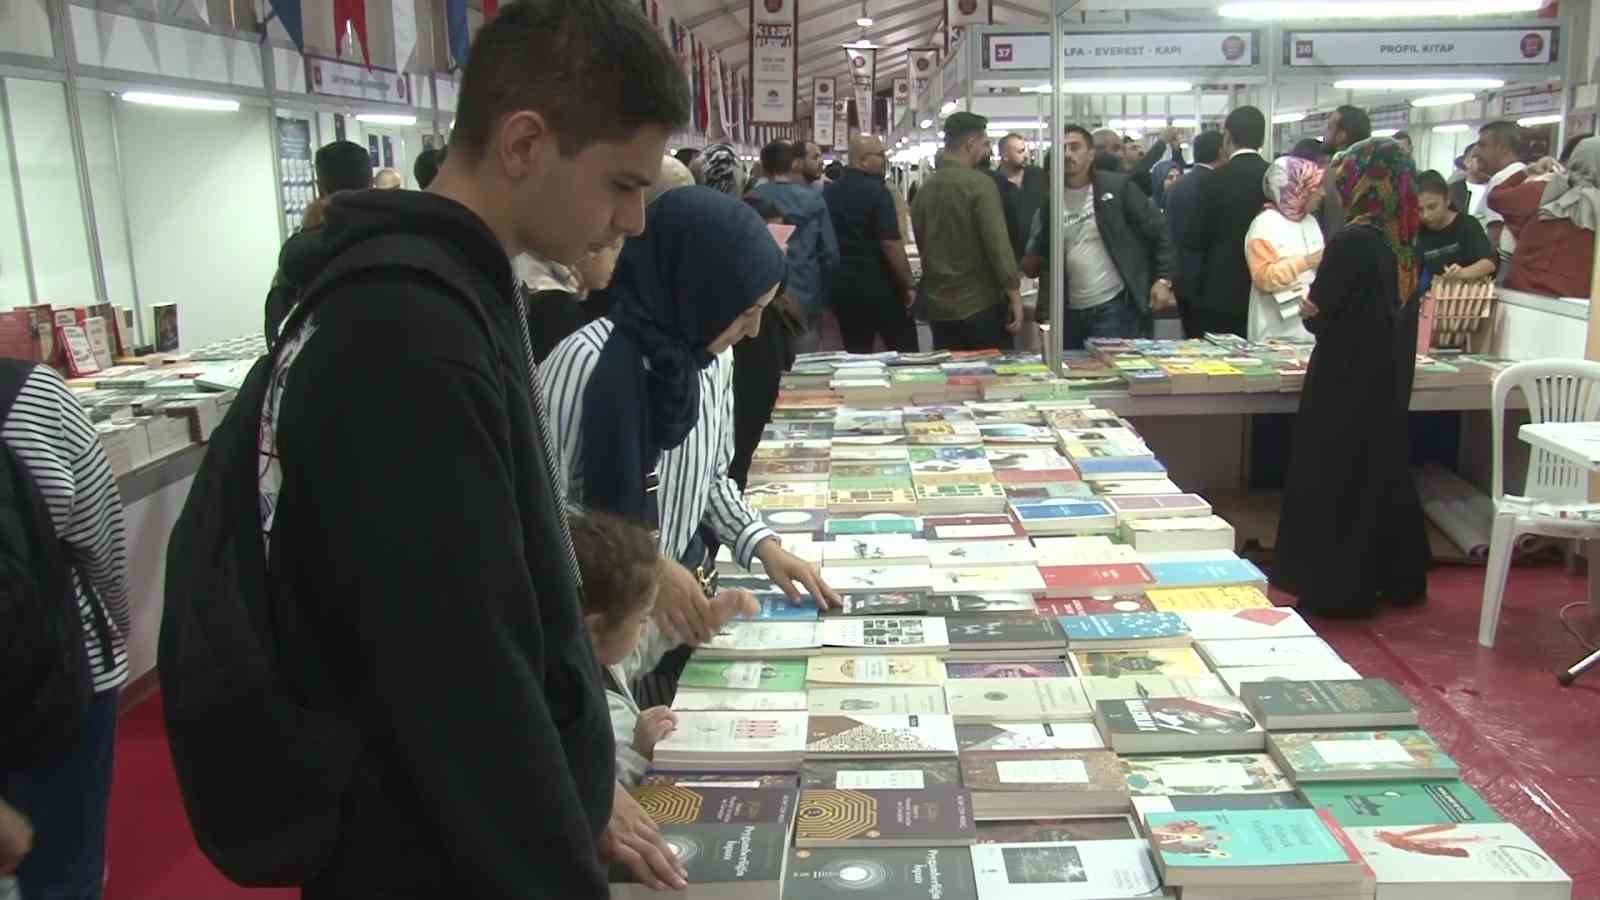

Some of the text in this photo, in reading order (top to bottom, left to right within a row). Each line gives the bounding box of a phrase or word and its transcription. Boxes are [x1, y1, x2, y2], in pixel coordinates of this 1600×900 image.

[1064, 47, 1085, 57] LFA
[1095, 46, 1144, 56] EVEREST
[1155, 45, 1182, 56] KAPI
